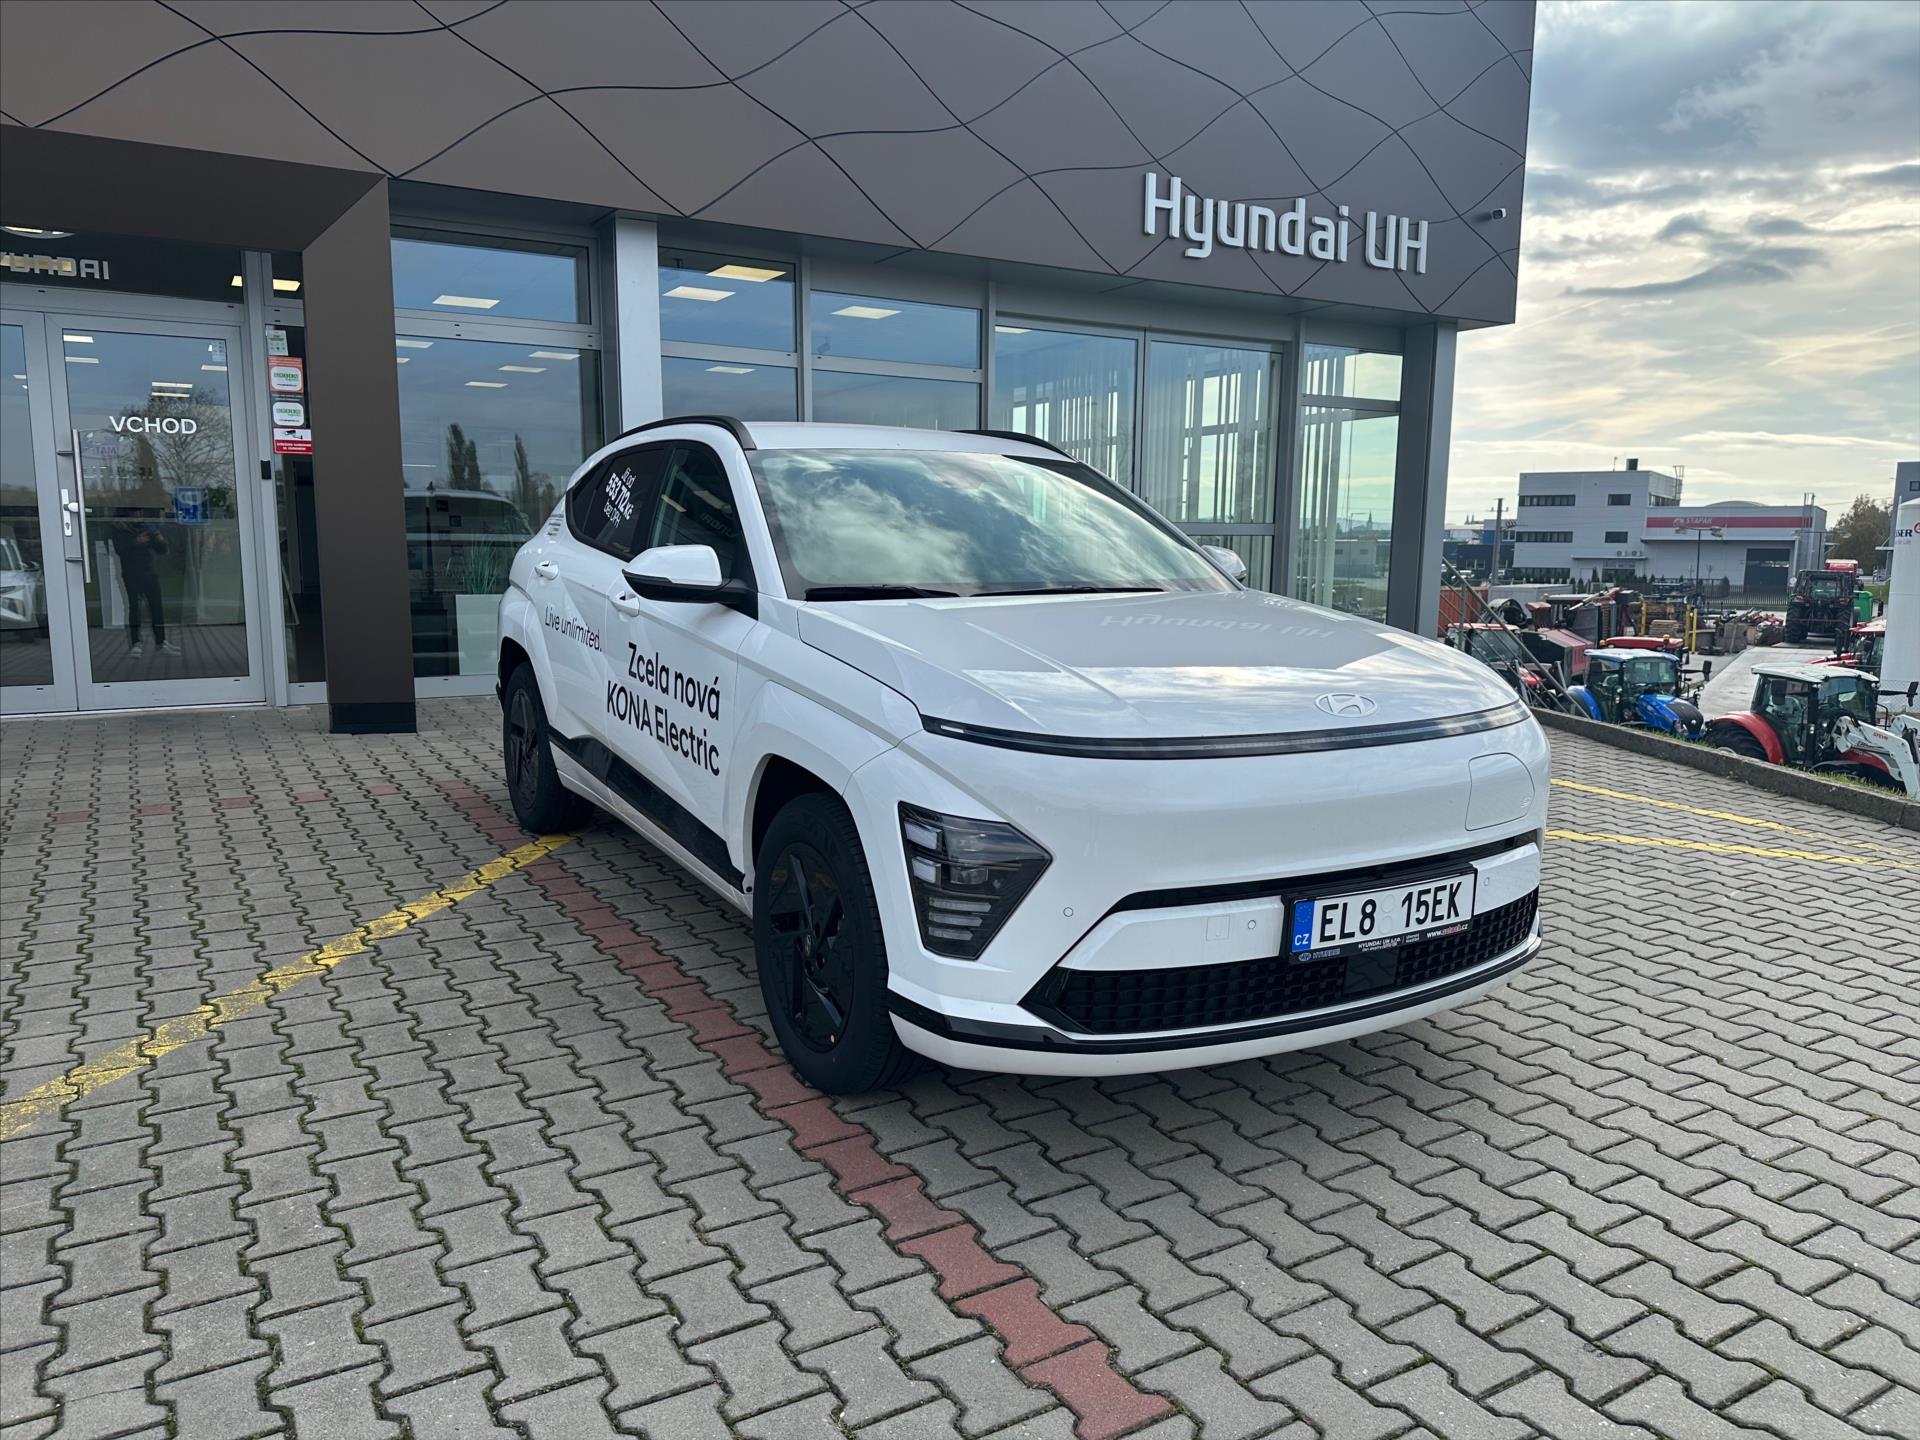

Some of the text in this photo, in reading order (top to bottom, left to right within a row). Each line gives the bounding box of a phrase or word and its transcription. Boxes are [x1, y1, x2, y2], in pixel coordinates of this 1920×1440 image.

[1144, 172, 1429, 275] Hyundai UH
[108, 415, 198, 435] VCHOD
[544, 605, 603, 653] Live unlimited.
[628, 642, 721, 721] Zcela nová
[607, 680, 721, 777] KONA Electric
[1294, 933, 1310, 946] CZ
[1319, 881, 1463, 943] EL8 15EK
